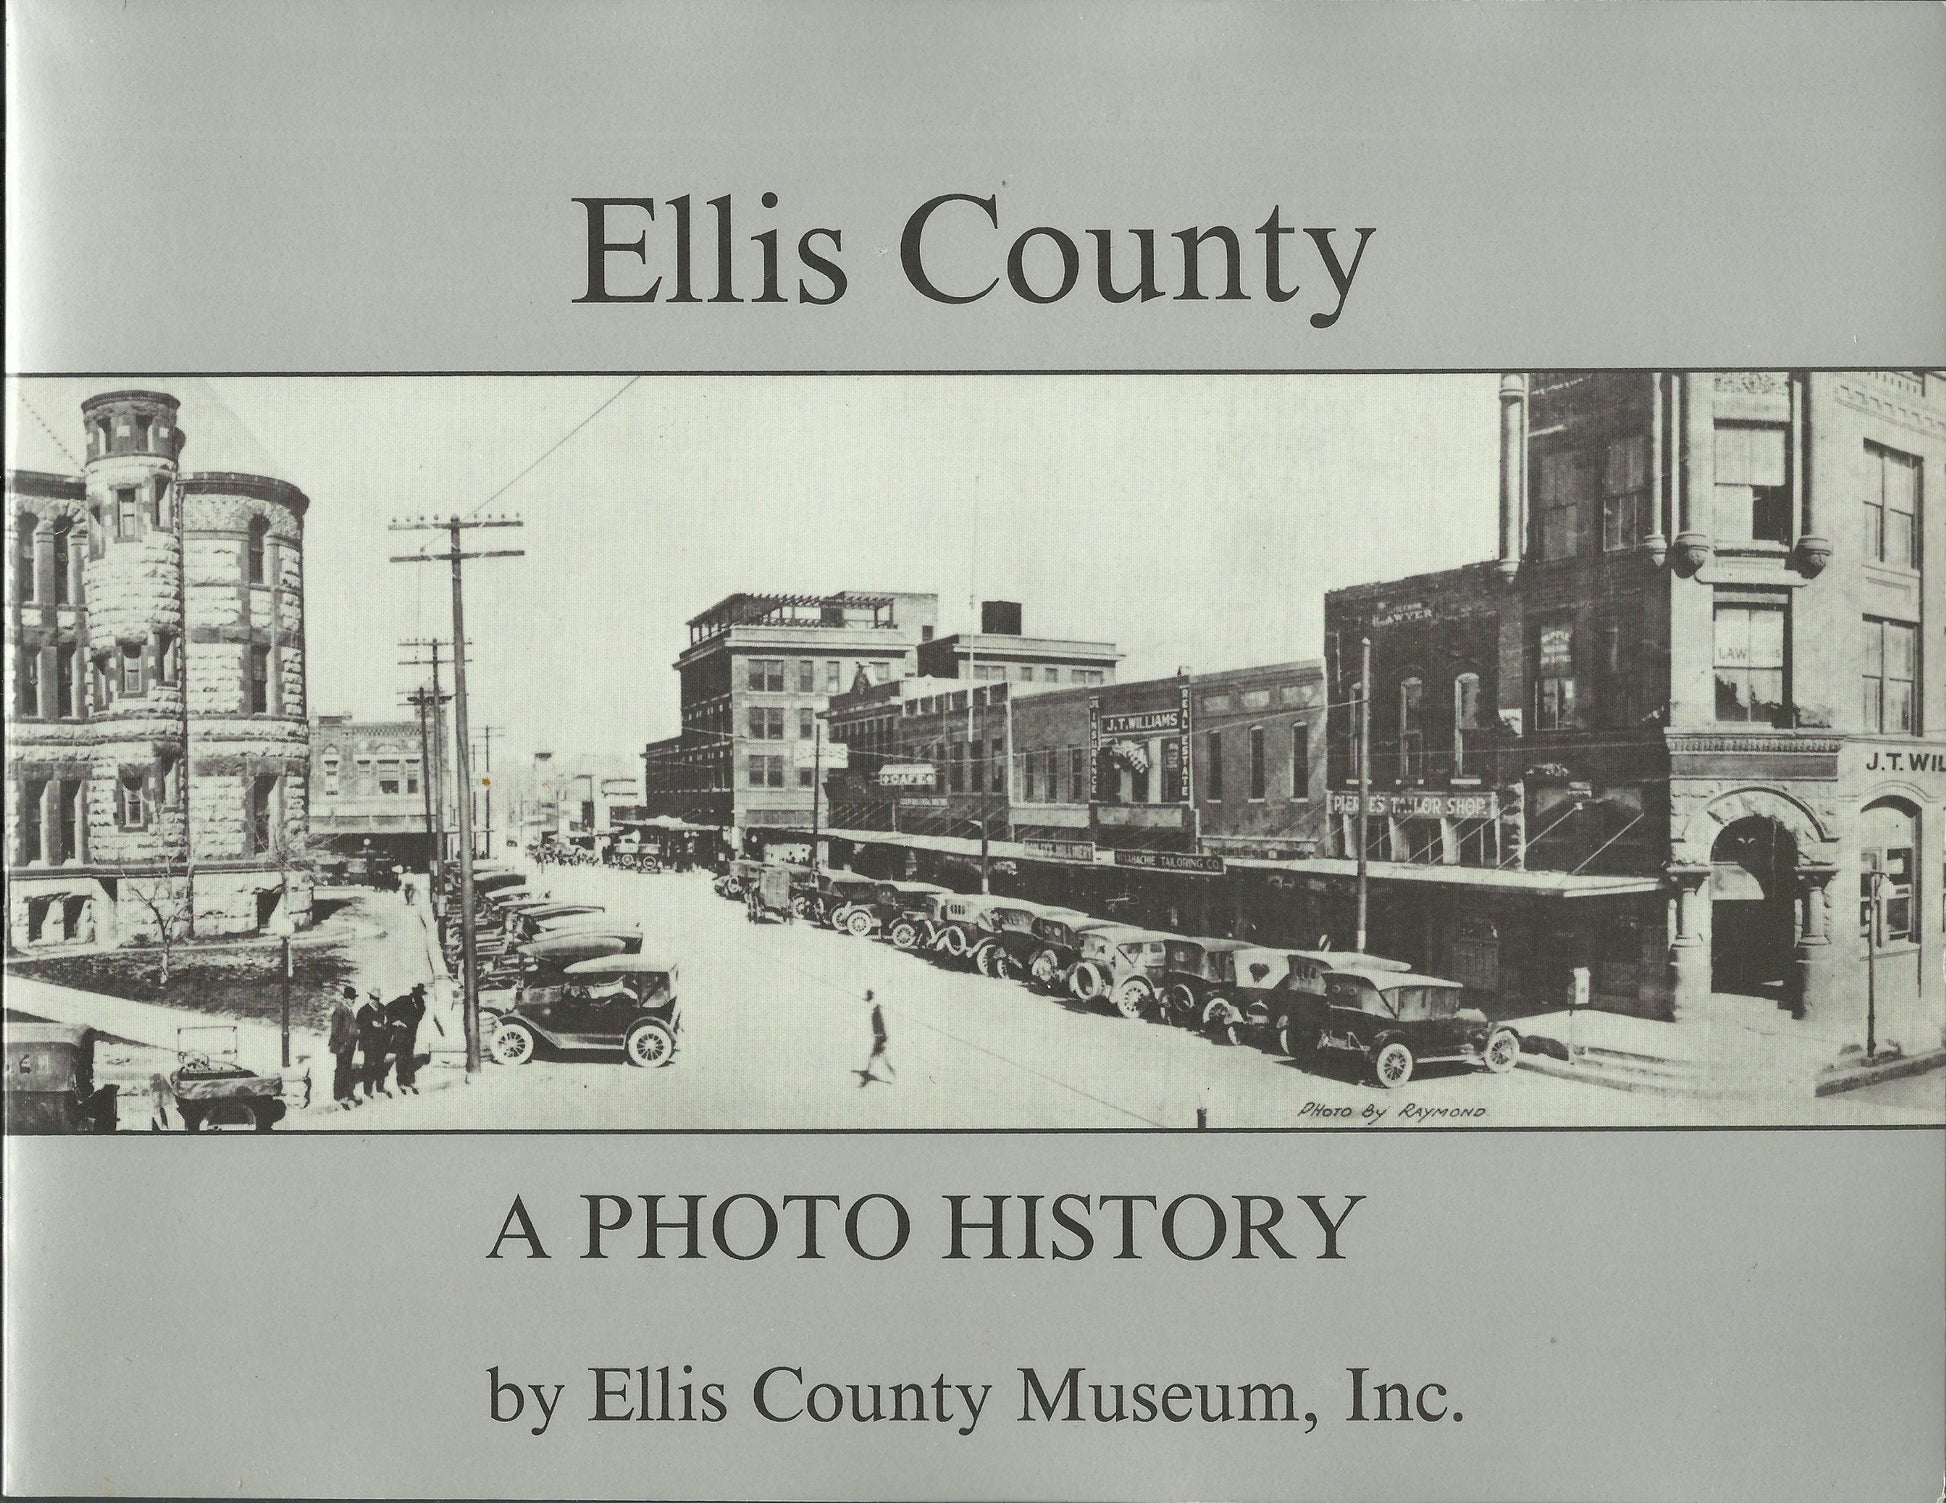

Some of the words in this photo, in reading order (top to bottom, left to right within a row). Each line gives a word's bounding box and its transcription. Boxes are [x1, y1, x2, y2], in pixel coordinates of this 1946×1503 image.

[572, 192, 847, 305] Ellis
[901, 194, 1376, 328] County
[1718, 648, 1748, 660] LAW
[1181, 689, 1189, 729] REAL
[1181, 735, 1189, 797] ESTATE
[1866, 752, 1904, 771] J.T.
[1334, 794, 1386, 813] PIERE'S
[1161, 856, 1203, 869] TAILORING
[486, 1194, 551, 1259] A
[580, 1194, 910, 1260] PHOTO
[942, 1194, 1366, 1260] HISTORY
[486, 1366, 565, 1435] by
[588, 1365, 727, 1422] Ellis
[754, 1367, 992, 1435] County
[1017, 1368, 1317, 1434] Museum,
[1346, 1368, 1463, 1422] Inc.
